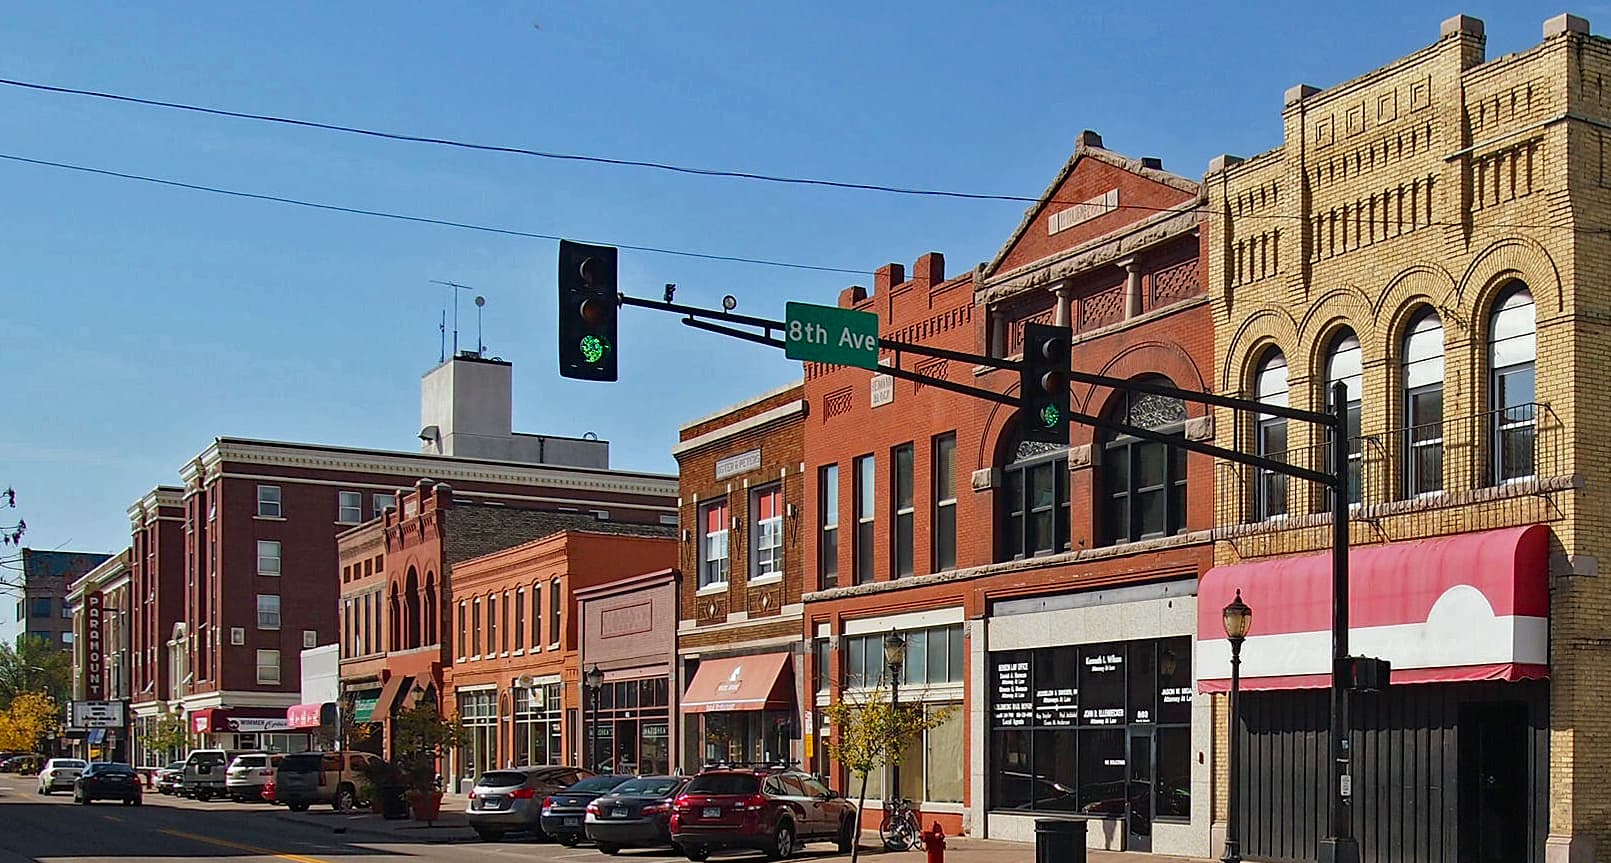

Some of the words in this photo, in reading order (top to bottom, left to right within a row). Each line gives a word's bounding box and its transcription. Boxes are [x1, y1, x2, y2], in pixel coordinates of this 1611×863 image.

[789, 320, 828, 345] 8th
[838, 327, 876, 352] Ave
[89, 597, 100, 694] PARAMOUNT
